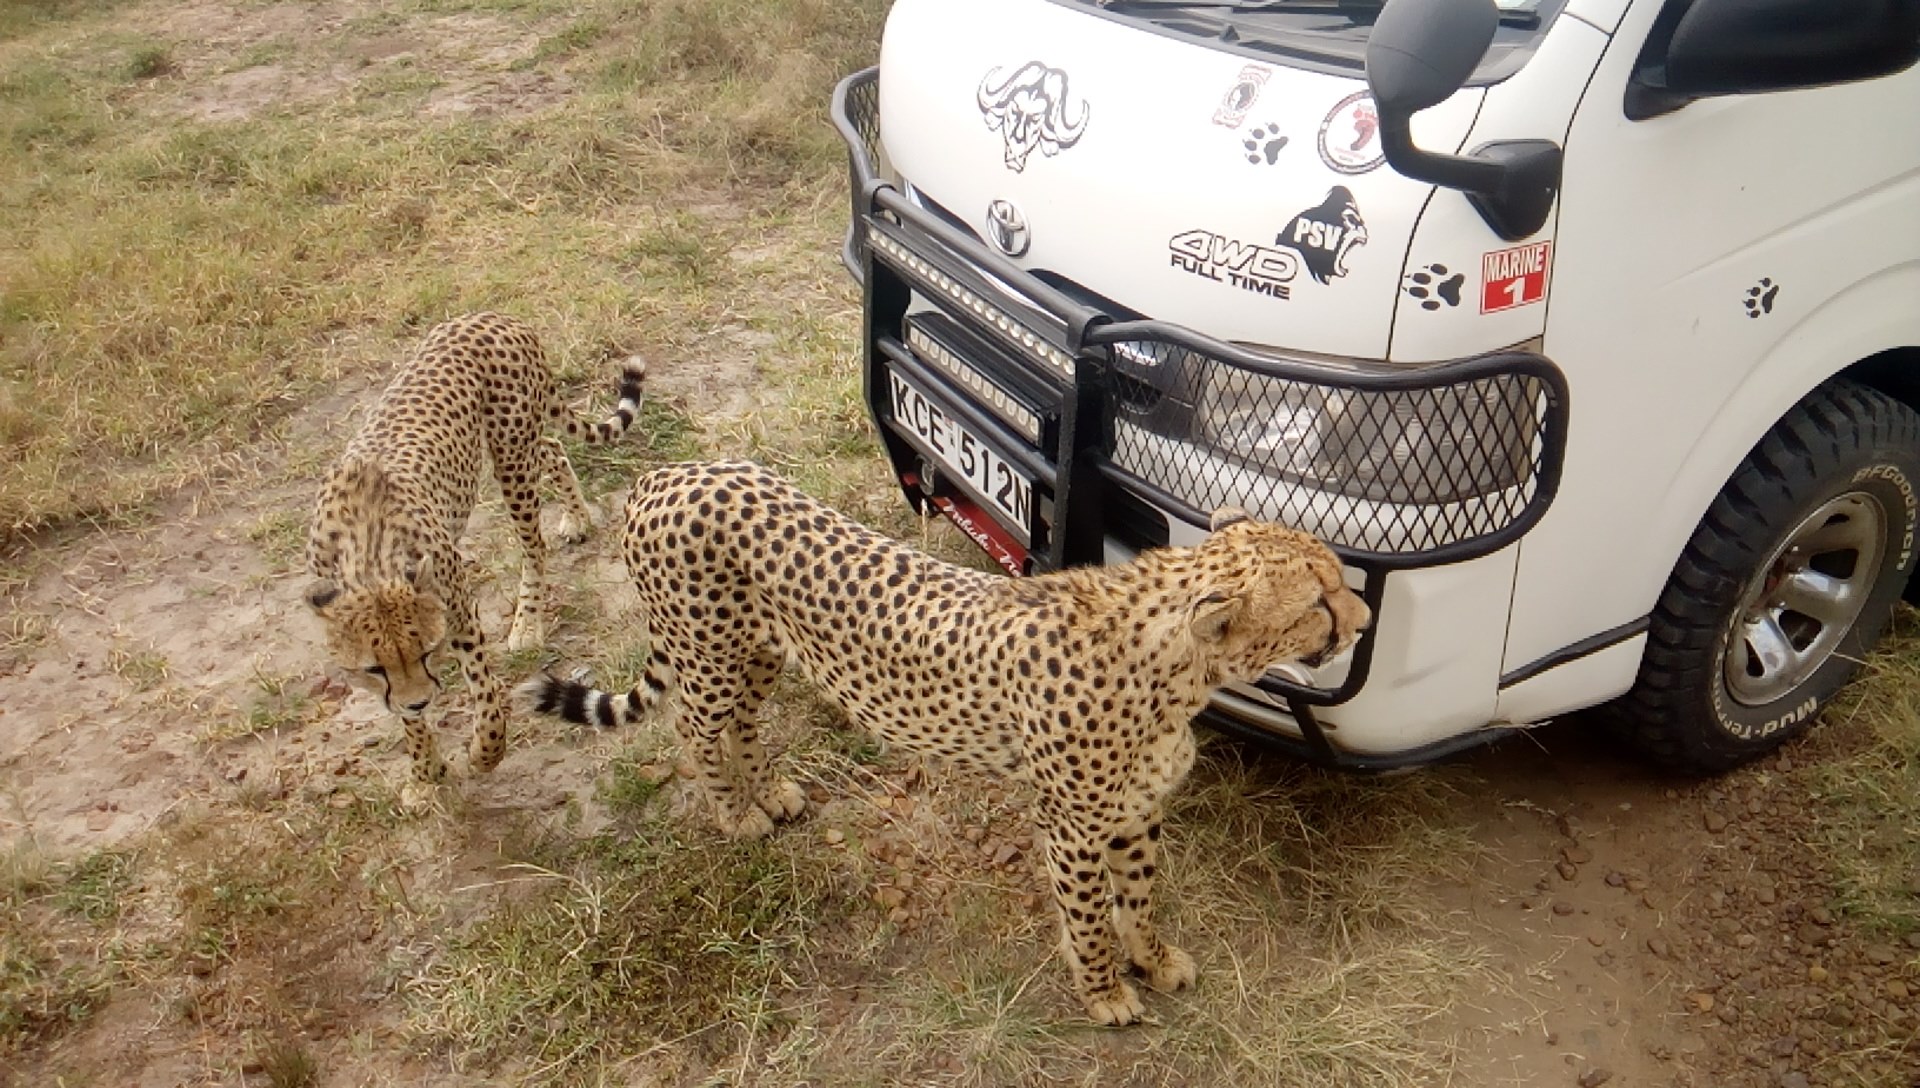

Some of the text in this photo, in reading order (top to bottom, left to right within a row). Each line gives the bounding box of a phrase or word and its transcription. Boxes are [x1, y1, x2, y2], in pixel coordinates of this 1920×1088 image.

[1294, 217, 1343, 250] PSV
[1169, 229, 1299, 282] 4WD
[1486, 246, 1544, 282] MARINE
[1171, 253, 1290, 300] FULL TIME
[1503, 277, 1525, 304] 1
[893, 376, 1032, 532] KCE 512N
